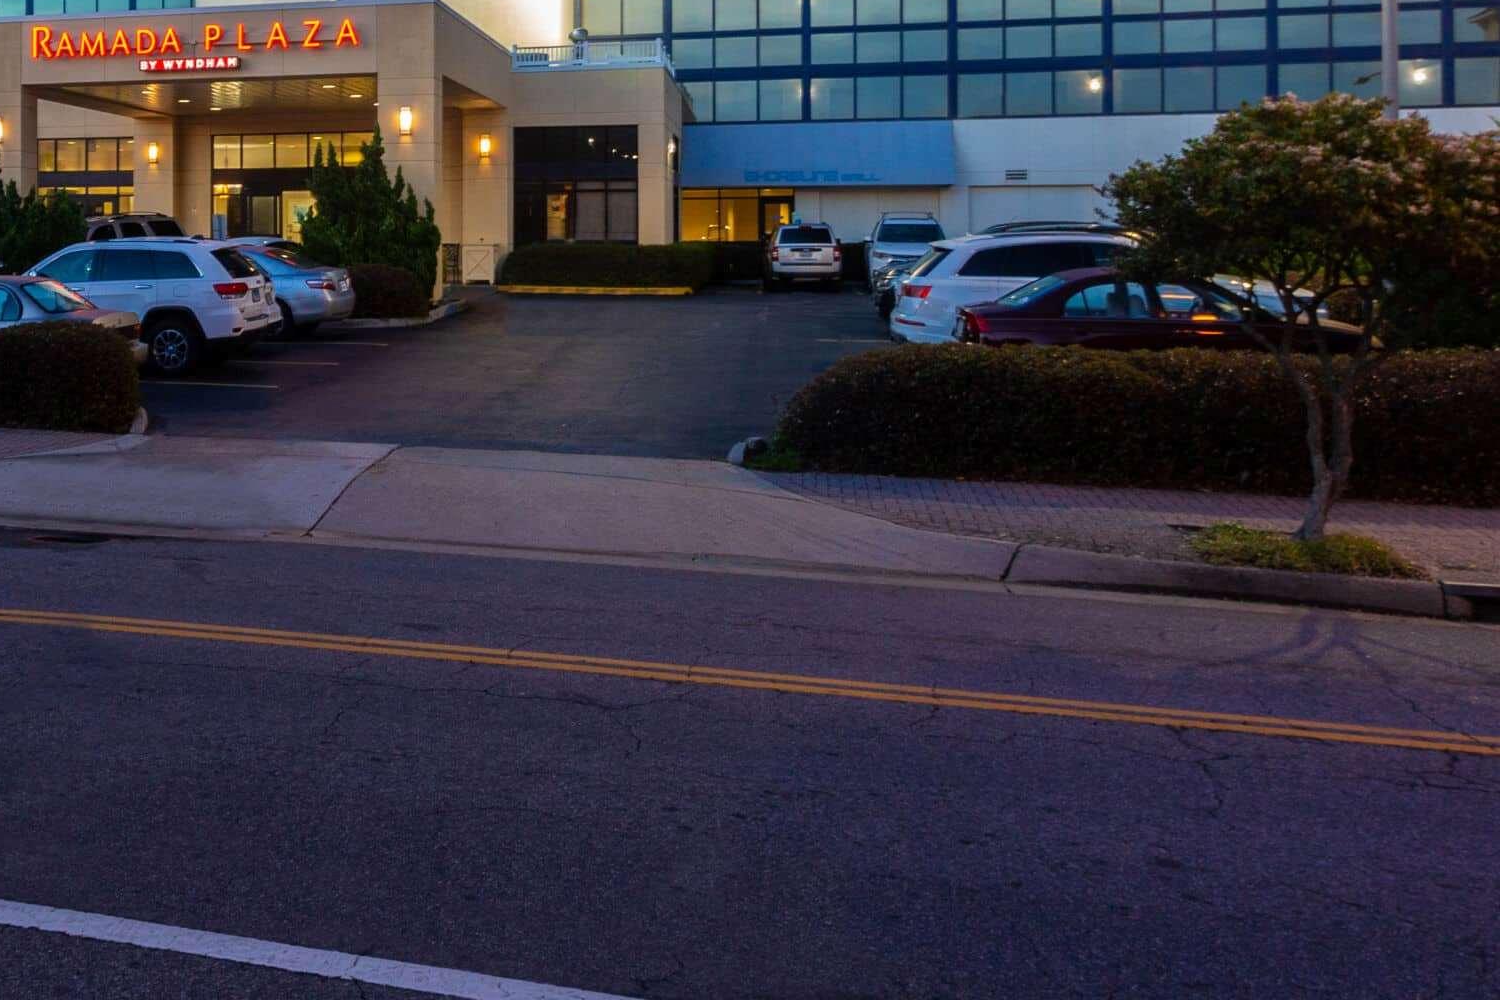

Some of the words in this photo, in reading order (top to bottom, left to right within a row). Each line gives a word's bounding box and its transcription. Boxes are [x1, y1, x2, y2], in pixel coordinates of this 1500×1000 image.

[31, 25, 181, 59] RAMADA
[204, 19, 361, 51] PLAZA
[140, 60, 157, 71] BY
[163, 57, 238, 71] WYNDHAM
